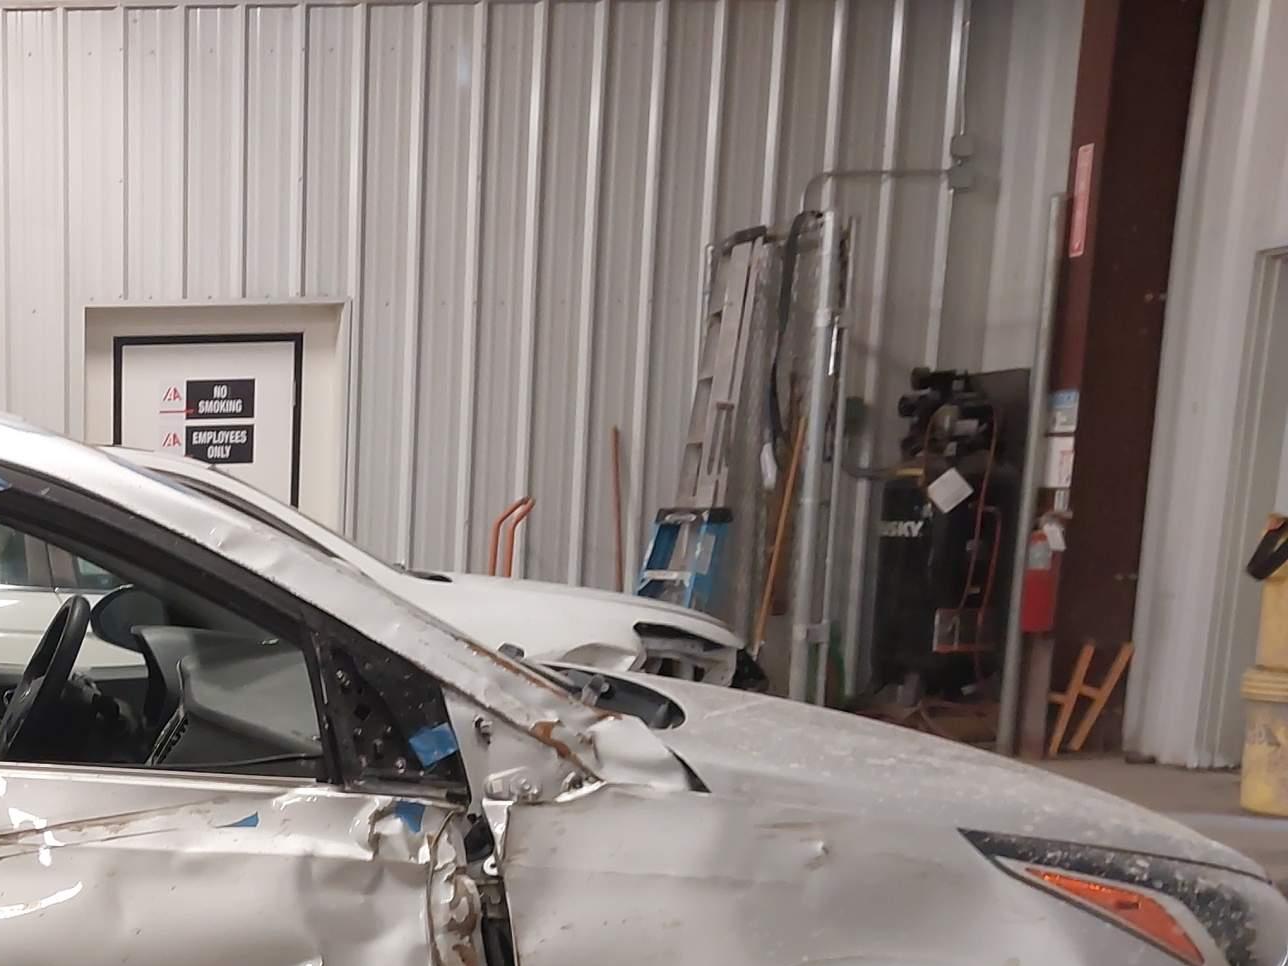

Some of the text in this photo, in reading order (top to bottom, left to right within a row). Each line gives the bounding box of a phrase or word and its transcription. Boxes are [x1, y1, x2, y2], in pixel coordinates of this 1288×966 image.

[213, 385, 228, 399] NO
[197, 399, 243, 414] SMOKING
[192, 430, 247, 445] EMPLOYEES
[207, 445, 231, 459] ONLY
